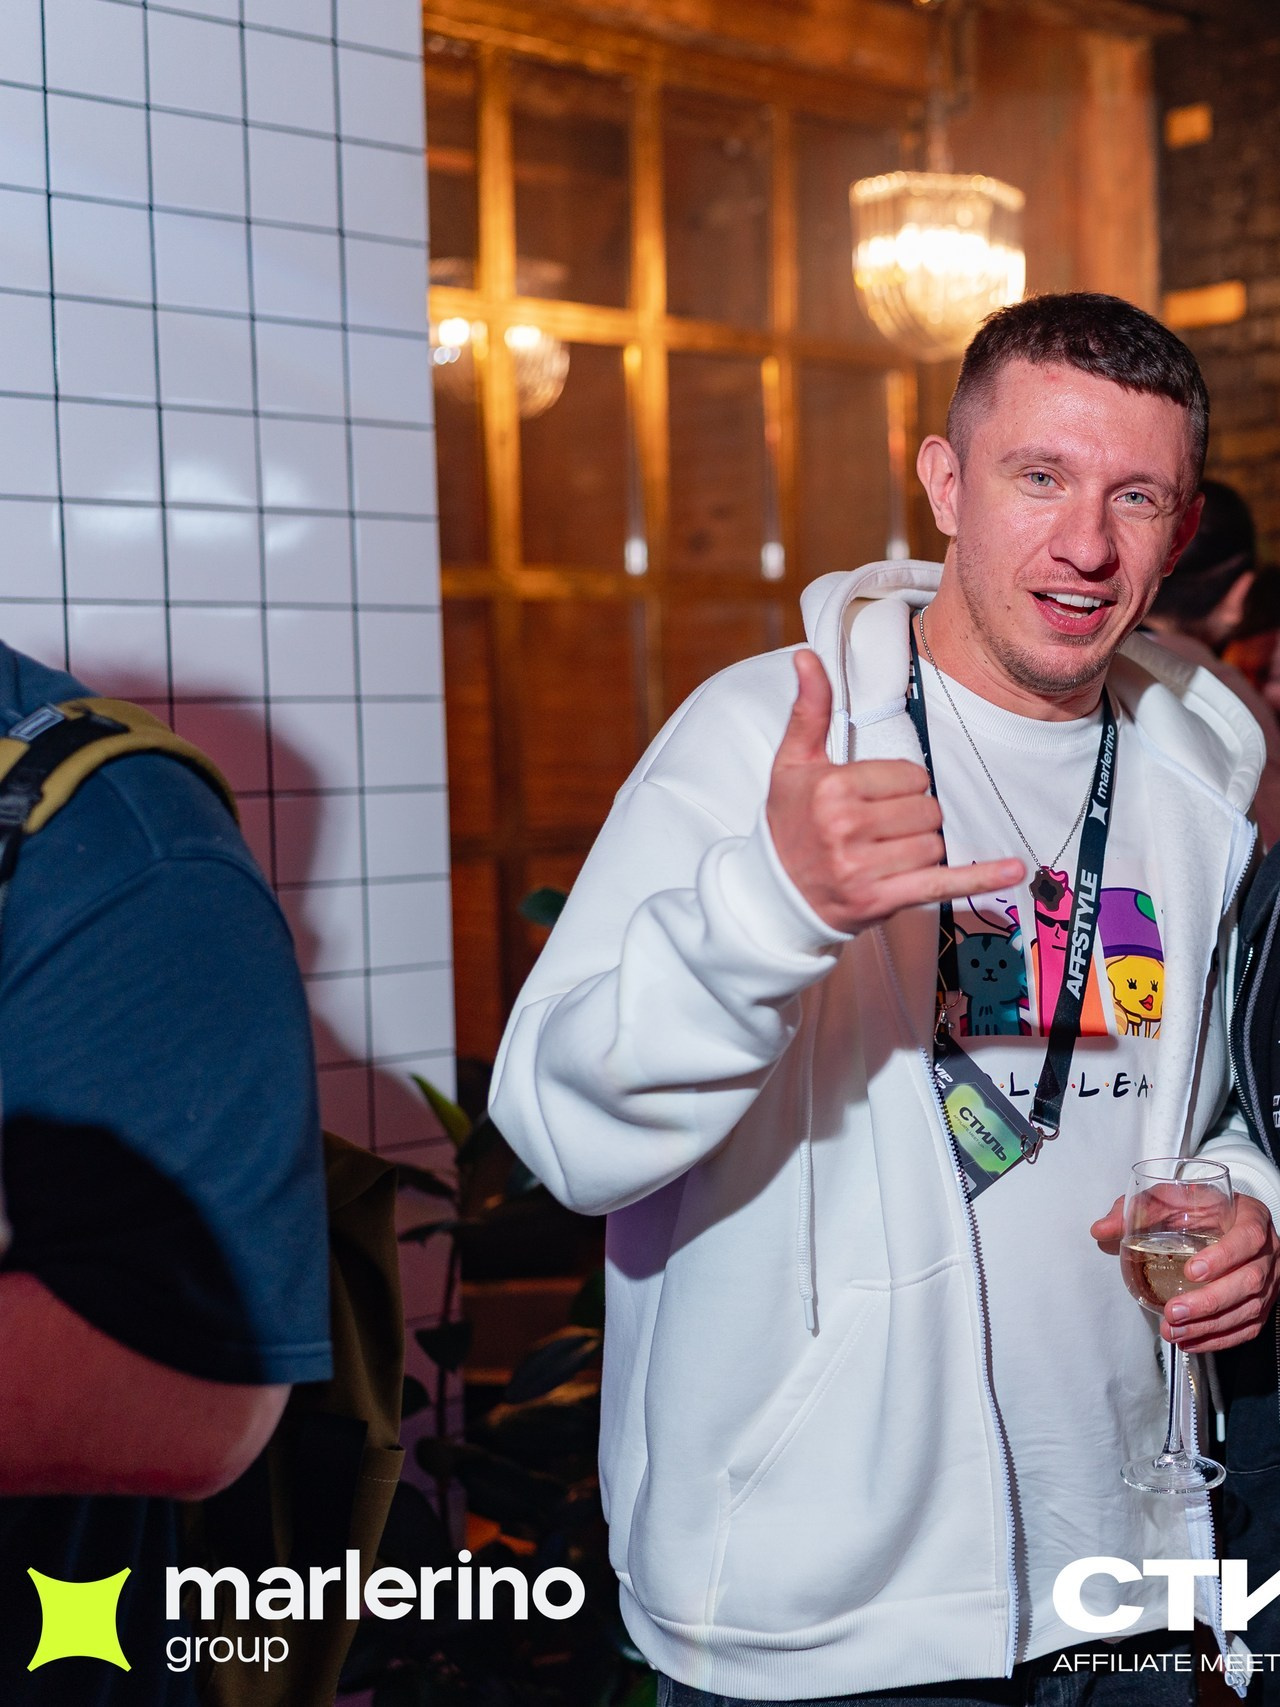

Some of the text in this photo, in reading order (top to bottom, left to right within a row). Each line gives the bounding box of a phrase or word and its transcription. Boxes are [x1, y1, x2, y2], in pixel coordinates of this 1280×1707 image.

[1097, 724, 1116, 800] marlerino
[1065, 868, 1098, 1001] AFFSTYLE
[959, 1106, 1007, 1162] СТИЛЬ
